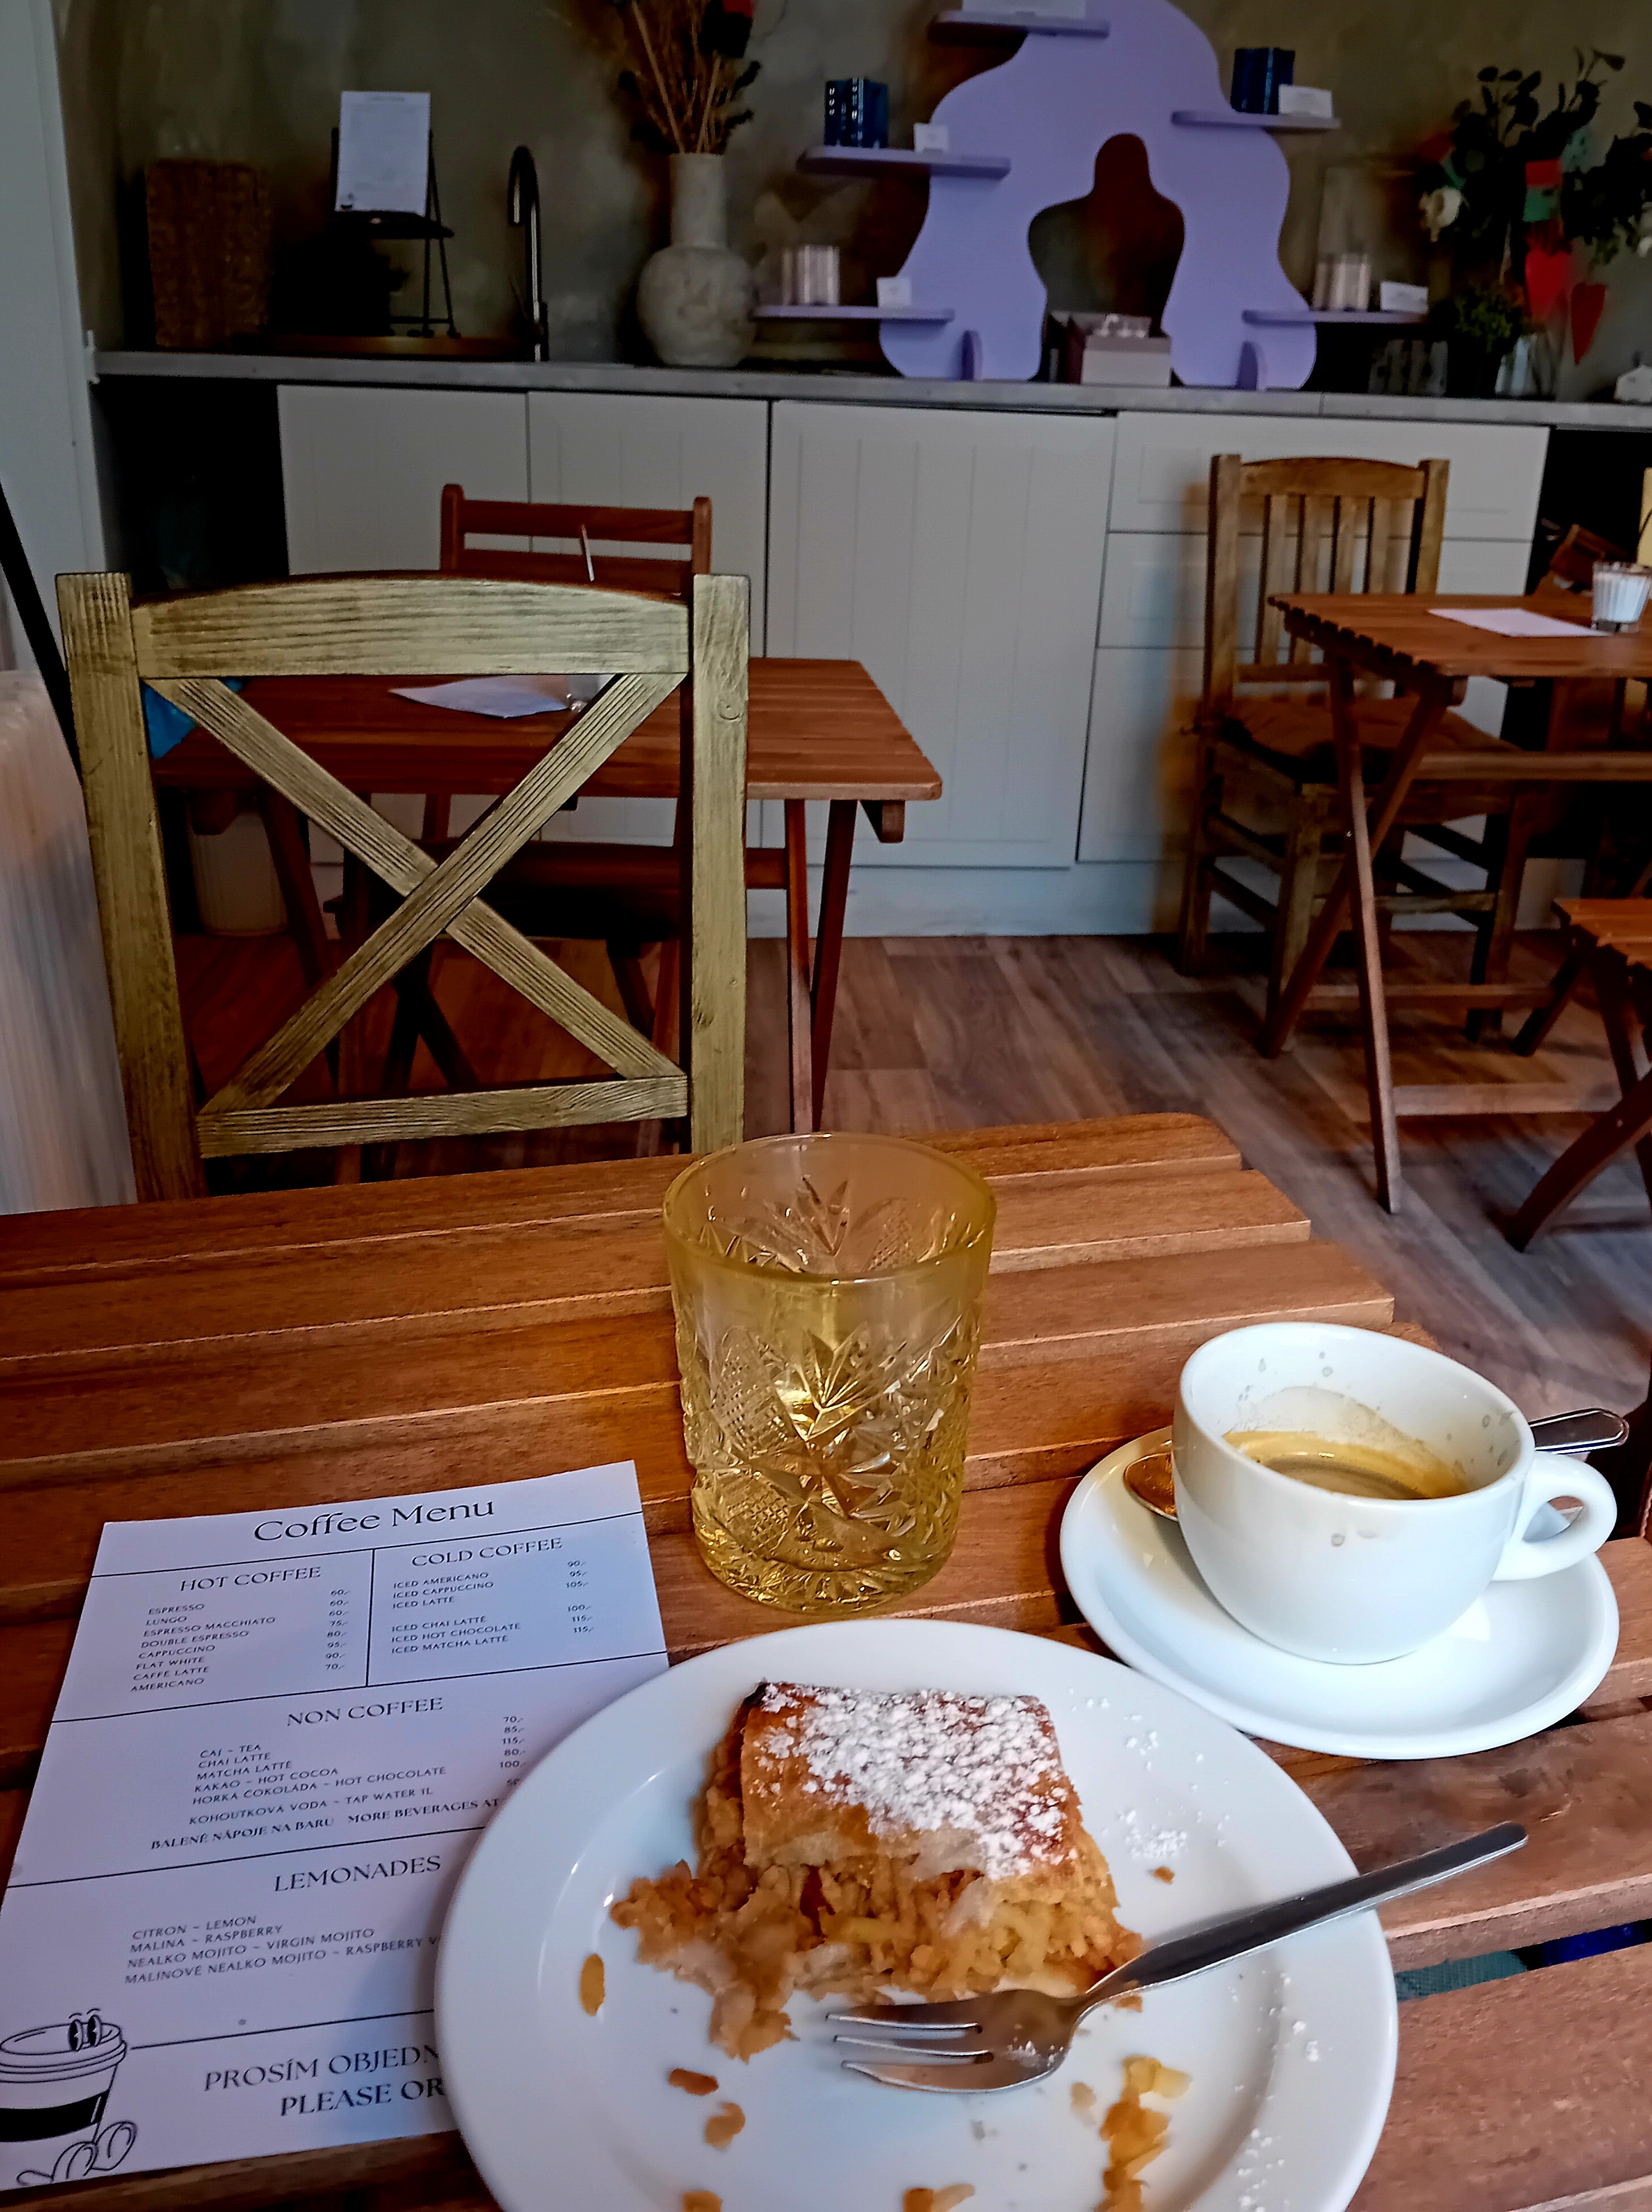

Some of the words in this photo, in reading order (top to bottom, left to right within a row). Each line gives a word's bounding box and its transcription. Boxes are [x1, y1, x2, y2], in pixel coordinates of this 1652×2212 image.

[254, 1513, 380, 1541] Coffee
[392, 1501, 495, 1527] Menu
[412, 1550, 473, 1567] COLD
[479, 1537, 562, 1559] COFFEE
[180, 1576, 229, 1592] HOT
[234, 1566, 321, 1586] COFFEE
[393, 1580, 419, 1589] ICED
[423, 1572, 489, 1586] AMERICANO
[393, 1590, 419, 1599] ICED
[422, 1581, 494, 1596] CAPPUCCINO
[148, 1603, 205, 1615] ESPRESSO
[392, 1600, 419, 1610] ICED
[422, 1595, 455, 1606] LATTE
[143, 1625, 202, 1637] ESPRESSO
[205, 1616, 276, 1630] MACCHIATO
[145, 1616, 188, 1626] LUNGO
[391, 1624, 419, 1633] ICED
[422, 1620, 450, 1629] CHAI
[454, 1615, 487, 1626] LATTE
[141, 1637, 188, 1648] DOUBLE
[191, 1630, 249, 1643] ESPRESSO
[391, 1634, 418, 1643] ICED
[422, 1631, 446, 1640] HOT
[450, 1623, 520, 1637] CHOCOLATE
[138, 1644, 216, 1659] CAPPUCCINO
[391, 1645, 419, 1654] ICED
[422, 1640, 471, 1651] MATCHA
[475, 1635, 508, 1645] LATTE
[136, 1660, 164, 1671] FLAT
[168, 1656, 204, 1666] WHITE
[174, 1666, 209, 1676] LATTE
[130, 1677, 205, 1692] AMERICANO
[287, 1708, 341, 1727] NON
[348, 1697, 443, 1719] COFFEE
[239, 1744, 261, 1753] TEA
[197, 1767, 250, 1781] MATCHA
[255, 1760, 292, 1773] LATTE
[198, 1757, 229, 1769] CHAI
[233, 1752, 271, 1765] LATTE
[194, 1780, 241, 1793] KAKAO
[258, 1773, 285, 1785] HOT
[289, 1767, 339, 1781] COCOA
[335, 1776, 362, 1787] HOT
[366, 1766, 446, 1783] CHOCOLATE
[289, 1799, 327, 1811] VODA
[345, 1794, 369, 1805] TAP
[373, 1789, 415, 1801] WATER
[270, 1823, 291, 1834] NA
[295, 1818, 334, 1831] BARU
[347, 1810, 390, 1823] MORE
[394, 1800, 479, 1818] BEVERAGES
[483, 1798, 500, 1811] AT
[274, 1855, 440, 1892] LEMONADES
[130, 1938, 185, 1952] MALINA
[205, 1924, 283, 1944] RASPBERRY
[132, 1924, 187, 1940] CITRON
[206, 1915, 257, 1931] LEMON
[127, 1952, 187, 1969] NEALKO
[191, 1944, 247, 1960] MOJITO
[266, 1936, 315, 1950] VIRGIN
[321, 1928, 375, 1944] MOJITO
[208, 1958, 266, 1974] NEALKO
[272, 1950, 326, 1965] MOJITO
[346, 1938, 423, 1956] RASPBERRY
[204, 2058, 318, 2092] PROSÍM
[281, 2083, 392, 2117] PLEASE
